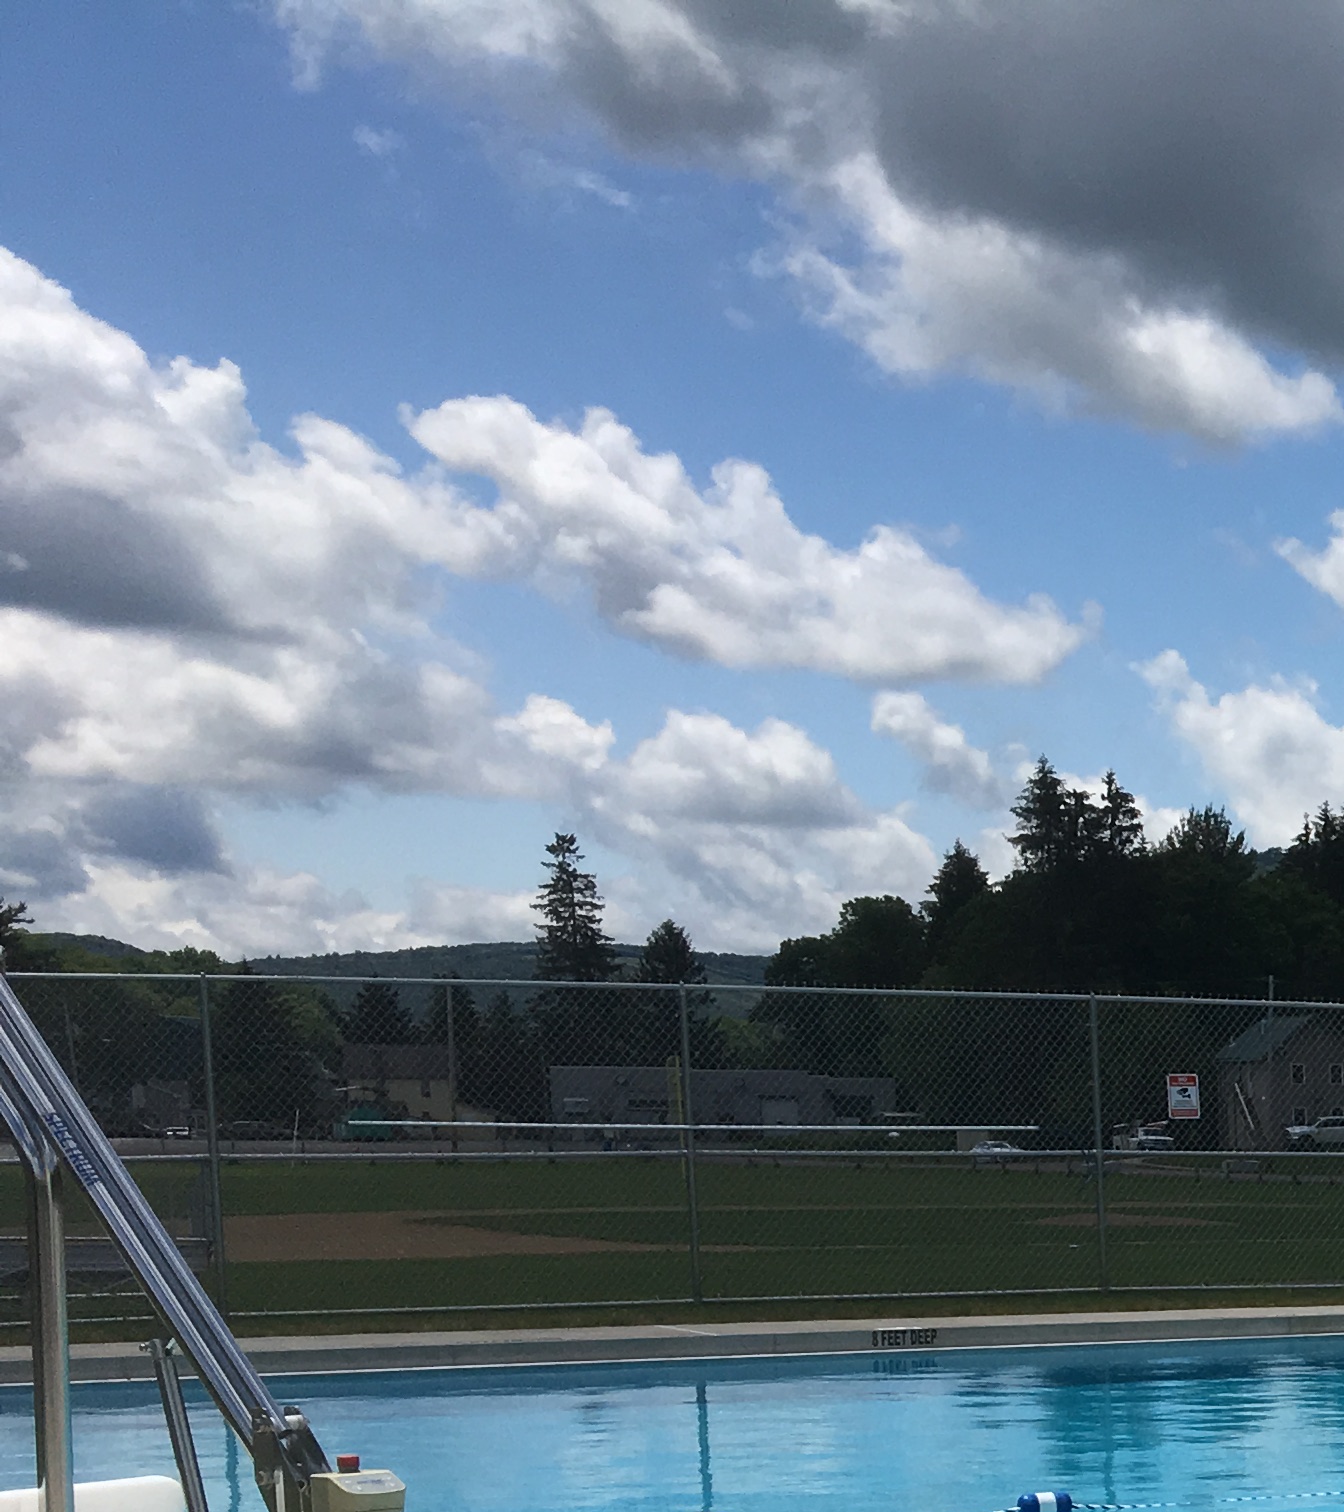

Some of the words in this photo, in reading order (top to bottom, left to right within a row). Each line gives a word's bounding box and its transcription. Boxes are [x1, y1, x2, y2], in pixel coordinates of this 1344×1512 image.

[43, 1112, 100, 1187] SPECTRUM
[871, 1330, 879, 1347] 8
[881, 1330, 907, 1346] FEET
[911, 1328, 937, 1345] DEEP
